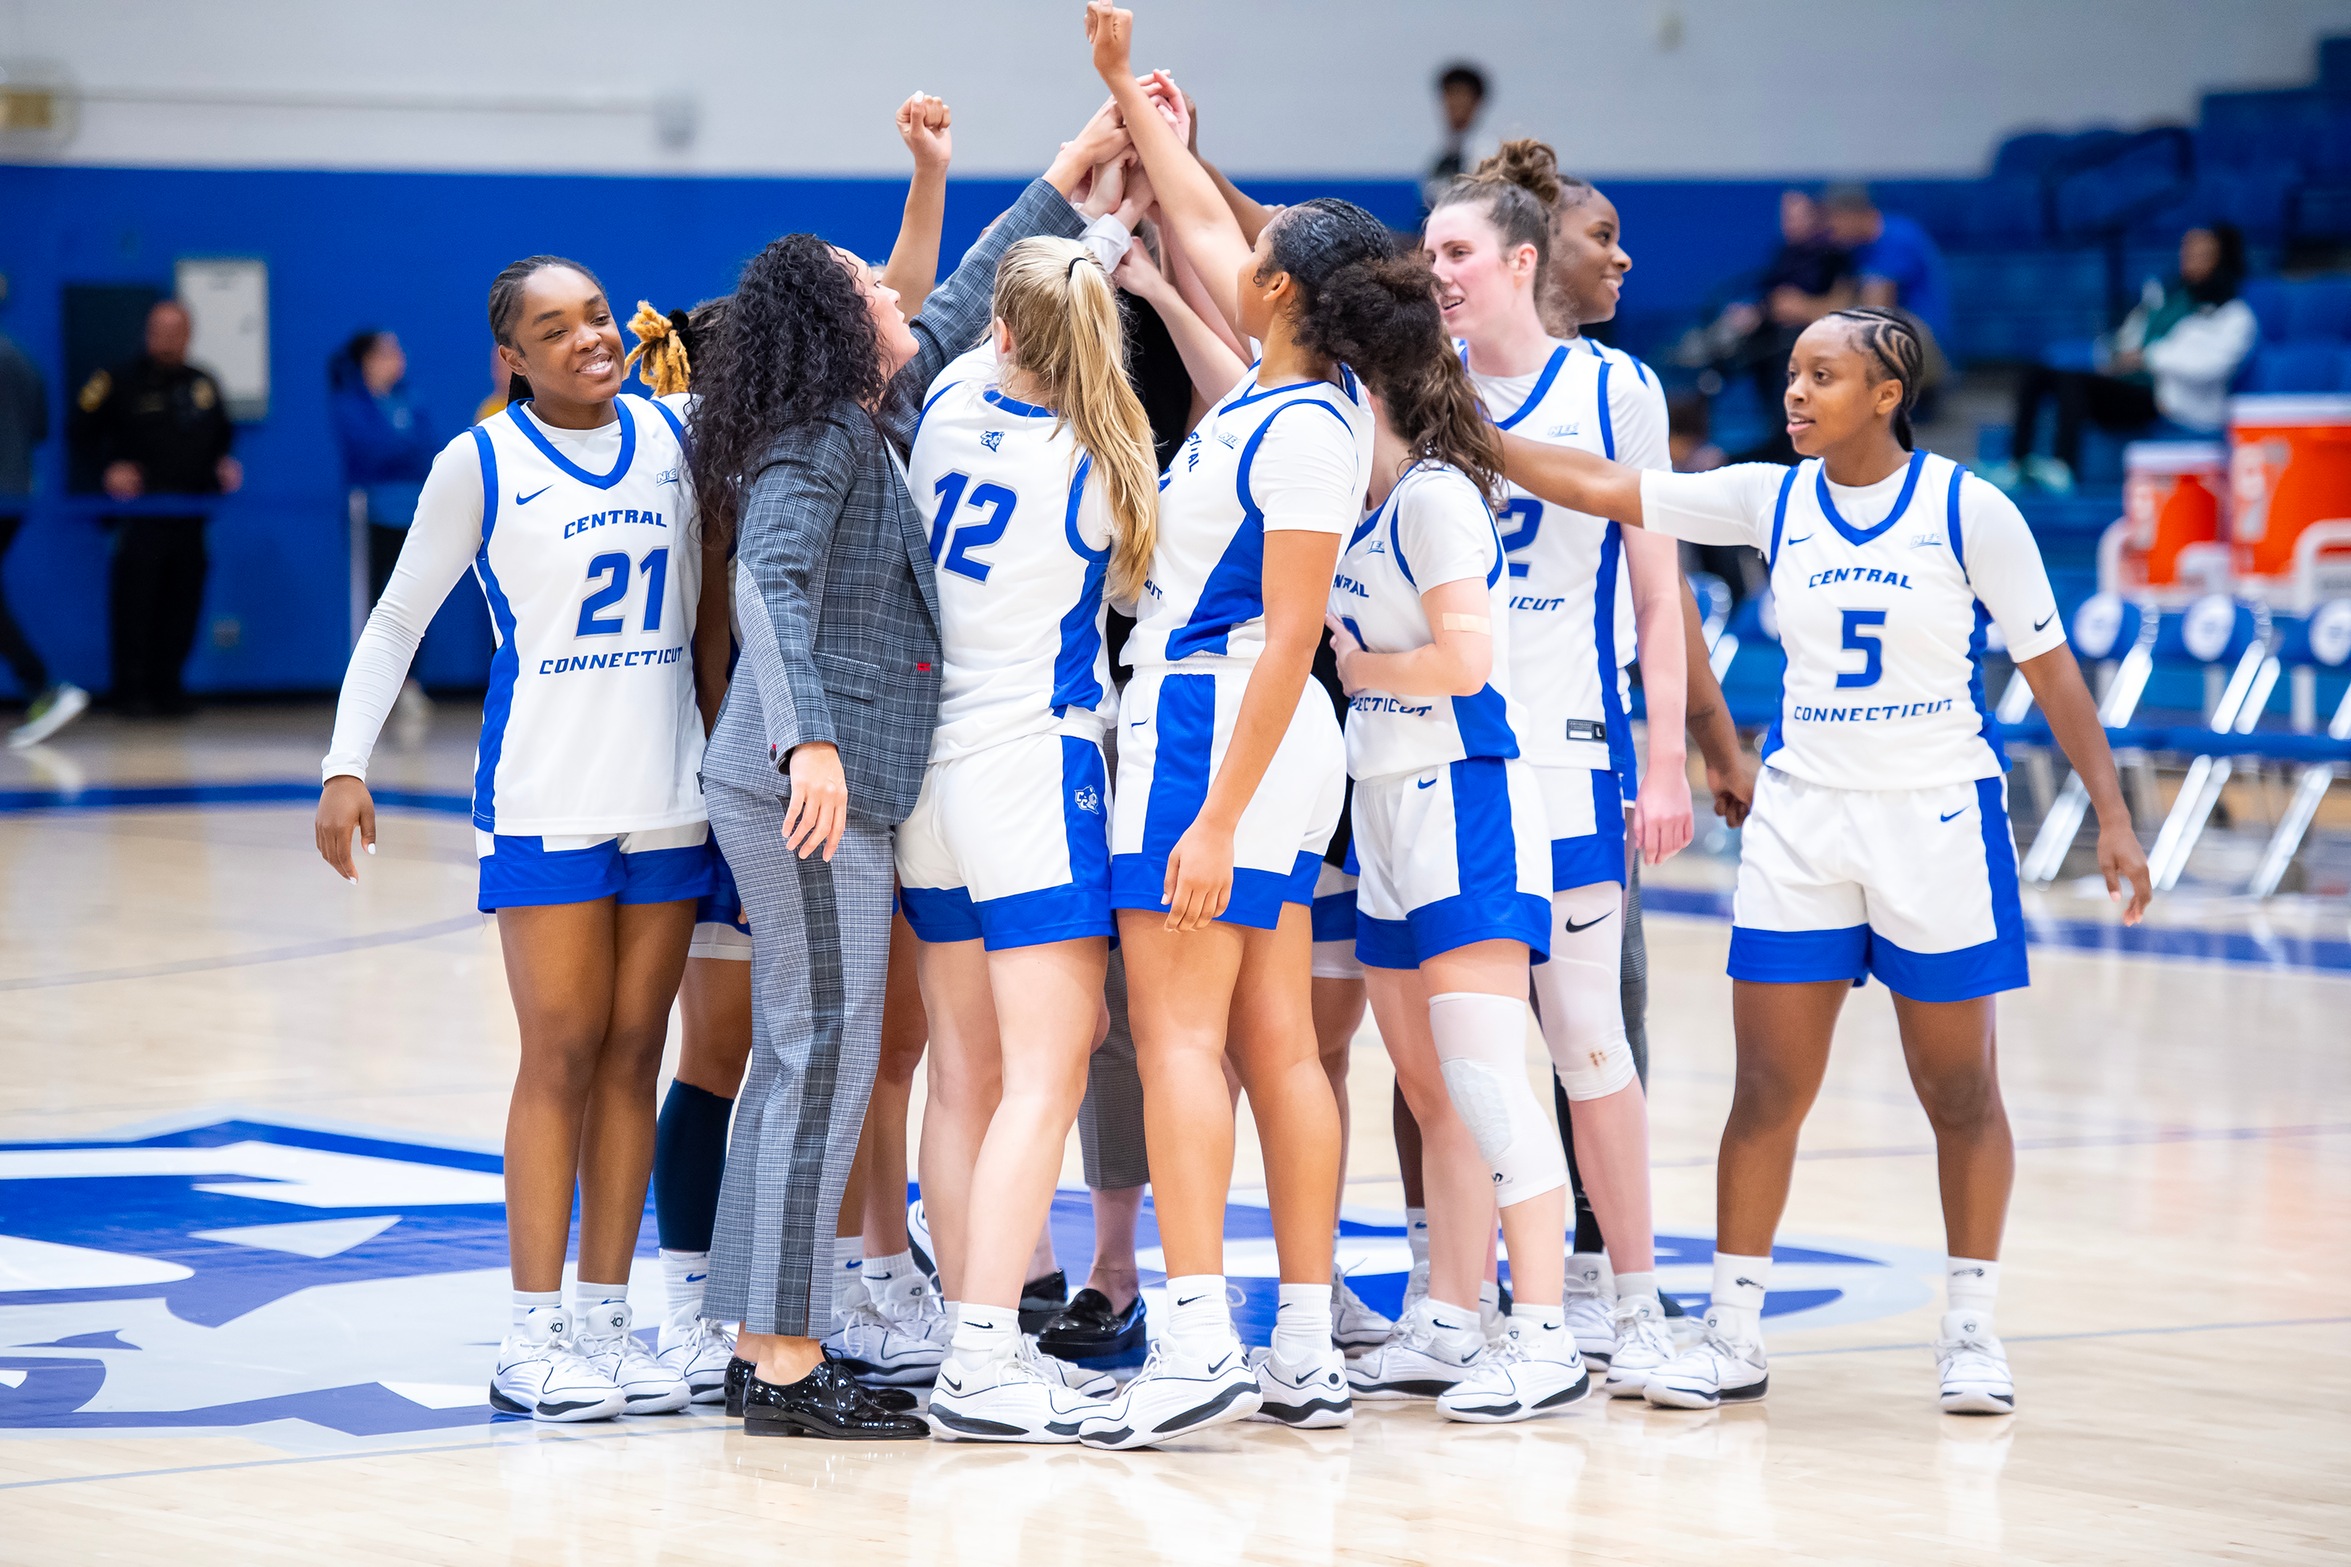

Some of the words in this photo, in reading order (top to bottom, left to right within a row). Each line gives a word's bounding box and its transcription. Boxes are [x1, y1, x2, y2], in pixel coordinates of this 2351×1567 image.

[563, 509, 667, 540] CENTRAL
[930, 468, 1019, 586] 12
[1498, 497, 1544, 579] 2
[574, 546, 671, 640] 21
[1808, 567, 1913, 590] CENTRAL
[538, 646, 684, 676] CONNECTICUT
[1834, 607, 1889, 690] 5
[1793, 698, 1953, 722] CONNECTICUT
